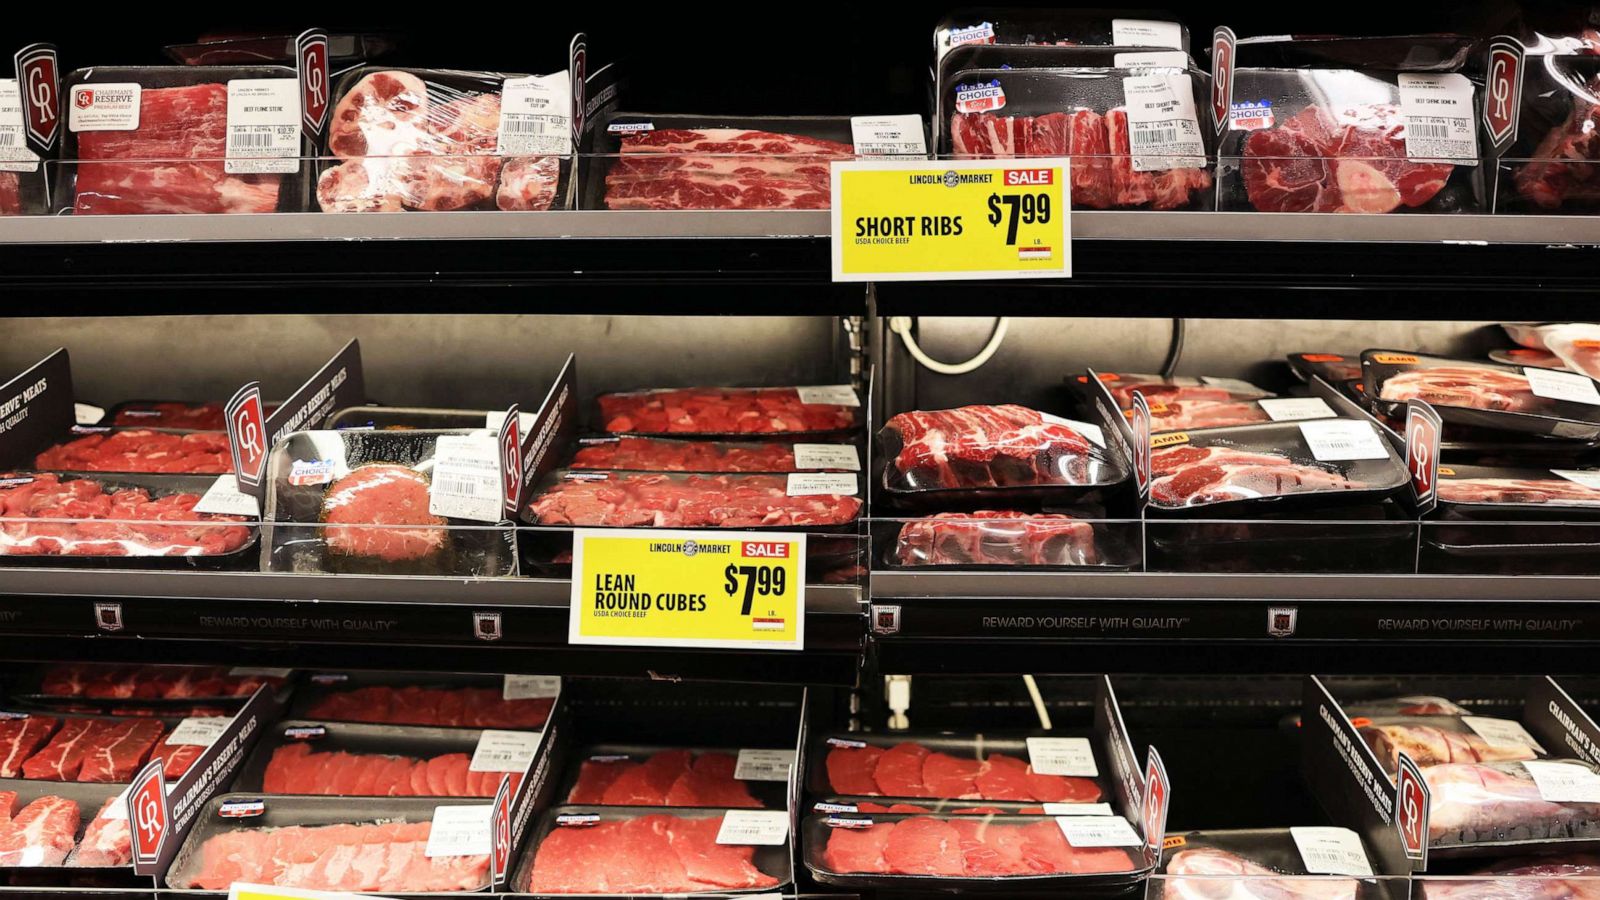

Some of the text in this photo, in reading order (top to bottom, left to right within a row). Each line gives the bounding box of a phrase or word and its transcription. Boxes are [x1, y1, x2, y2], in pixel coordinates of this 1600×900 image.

[952, 31, 989, 43] CHOICE
[95, 95, 133, 103] RESERVE
[959, 89, 999, 101] CHOICE
[1230, 109, 1269, 119] CHOICE
[909, 170, 1048, 184] LINCOLN MARKET SALE
[856, 216, 963, 237] SHORT RIBS
[855, 237, 871, 245] USDA
[23, 377, 47, 403] MEATS
[5, 407, 28, 430] QUALITY
[1154, 435, 1184, 444] AMB
[295, 467, 329, 476] CHOICE
[649, 543, 785, 557] LINCOLN MARKET SALE
[596, 573, 635, 592] LEAN
[595, 592, 707, 612] ROUND CUBES
[611, 610, 631, 618] CHOICE
[199, 615, 249, 628] REWARD
[249, 616, 309, 629] YOURSELF
[310, 618, 340, 630] WITH
[983, 616, 1035, 628] REWARD
[1037, 617, 1098, 629] YOURSELF
[1100, 618, 1129, 629] WITH
[1378, 618, 1429, 630] REWARD
[1431, 618, 1491, 630] YOURSELF
[1493, 619, 1522, 630] WITH
[1549, 700, 1590, 750] CHAIRMAN'S
[1319, 704, 1392, 814] CHAIRMAN'S RESERVE MEATS
[173, 716, 257, 820] CHAIRMAN'S RESERVE MEATS
[138, 790, 162, 843] CR
[1402, 778, 1418, 844] CR
